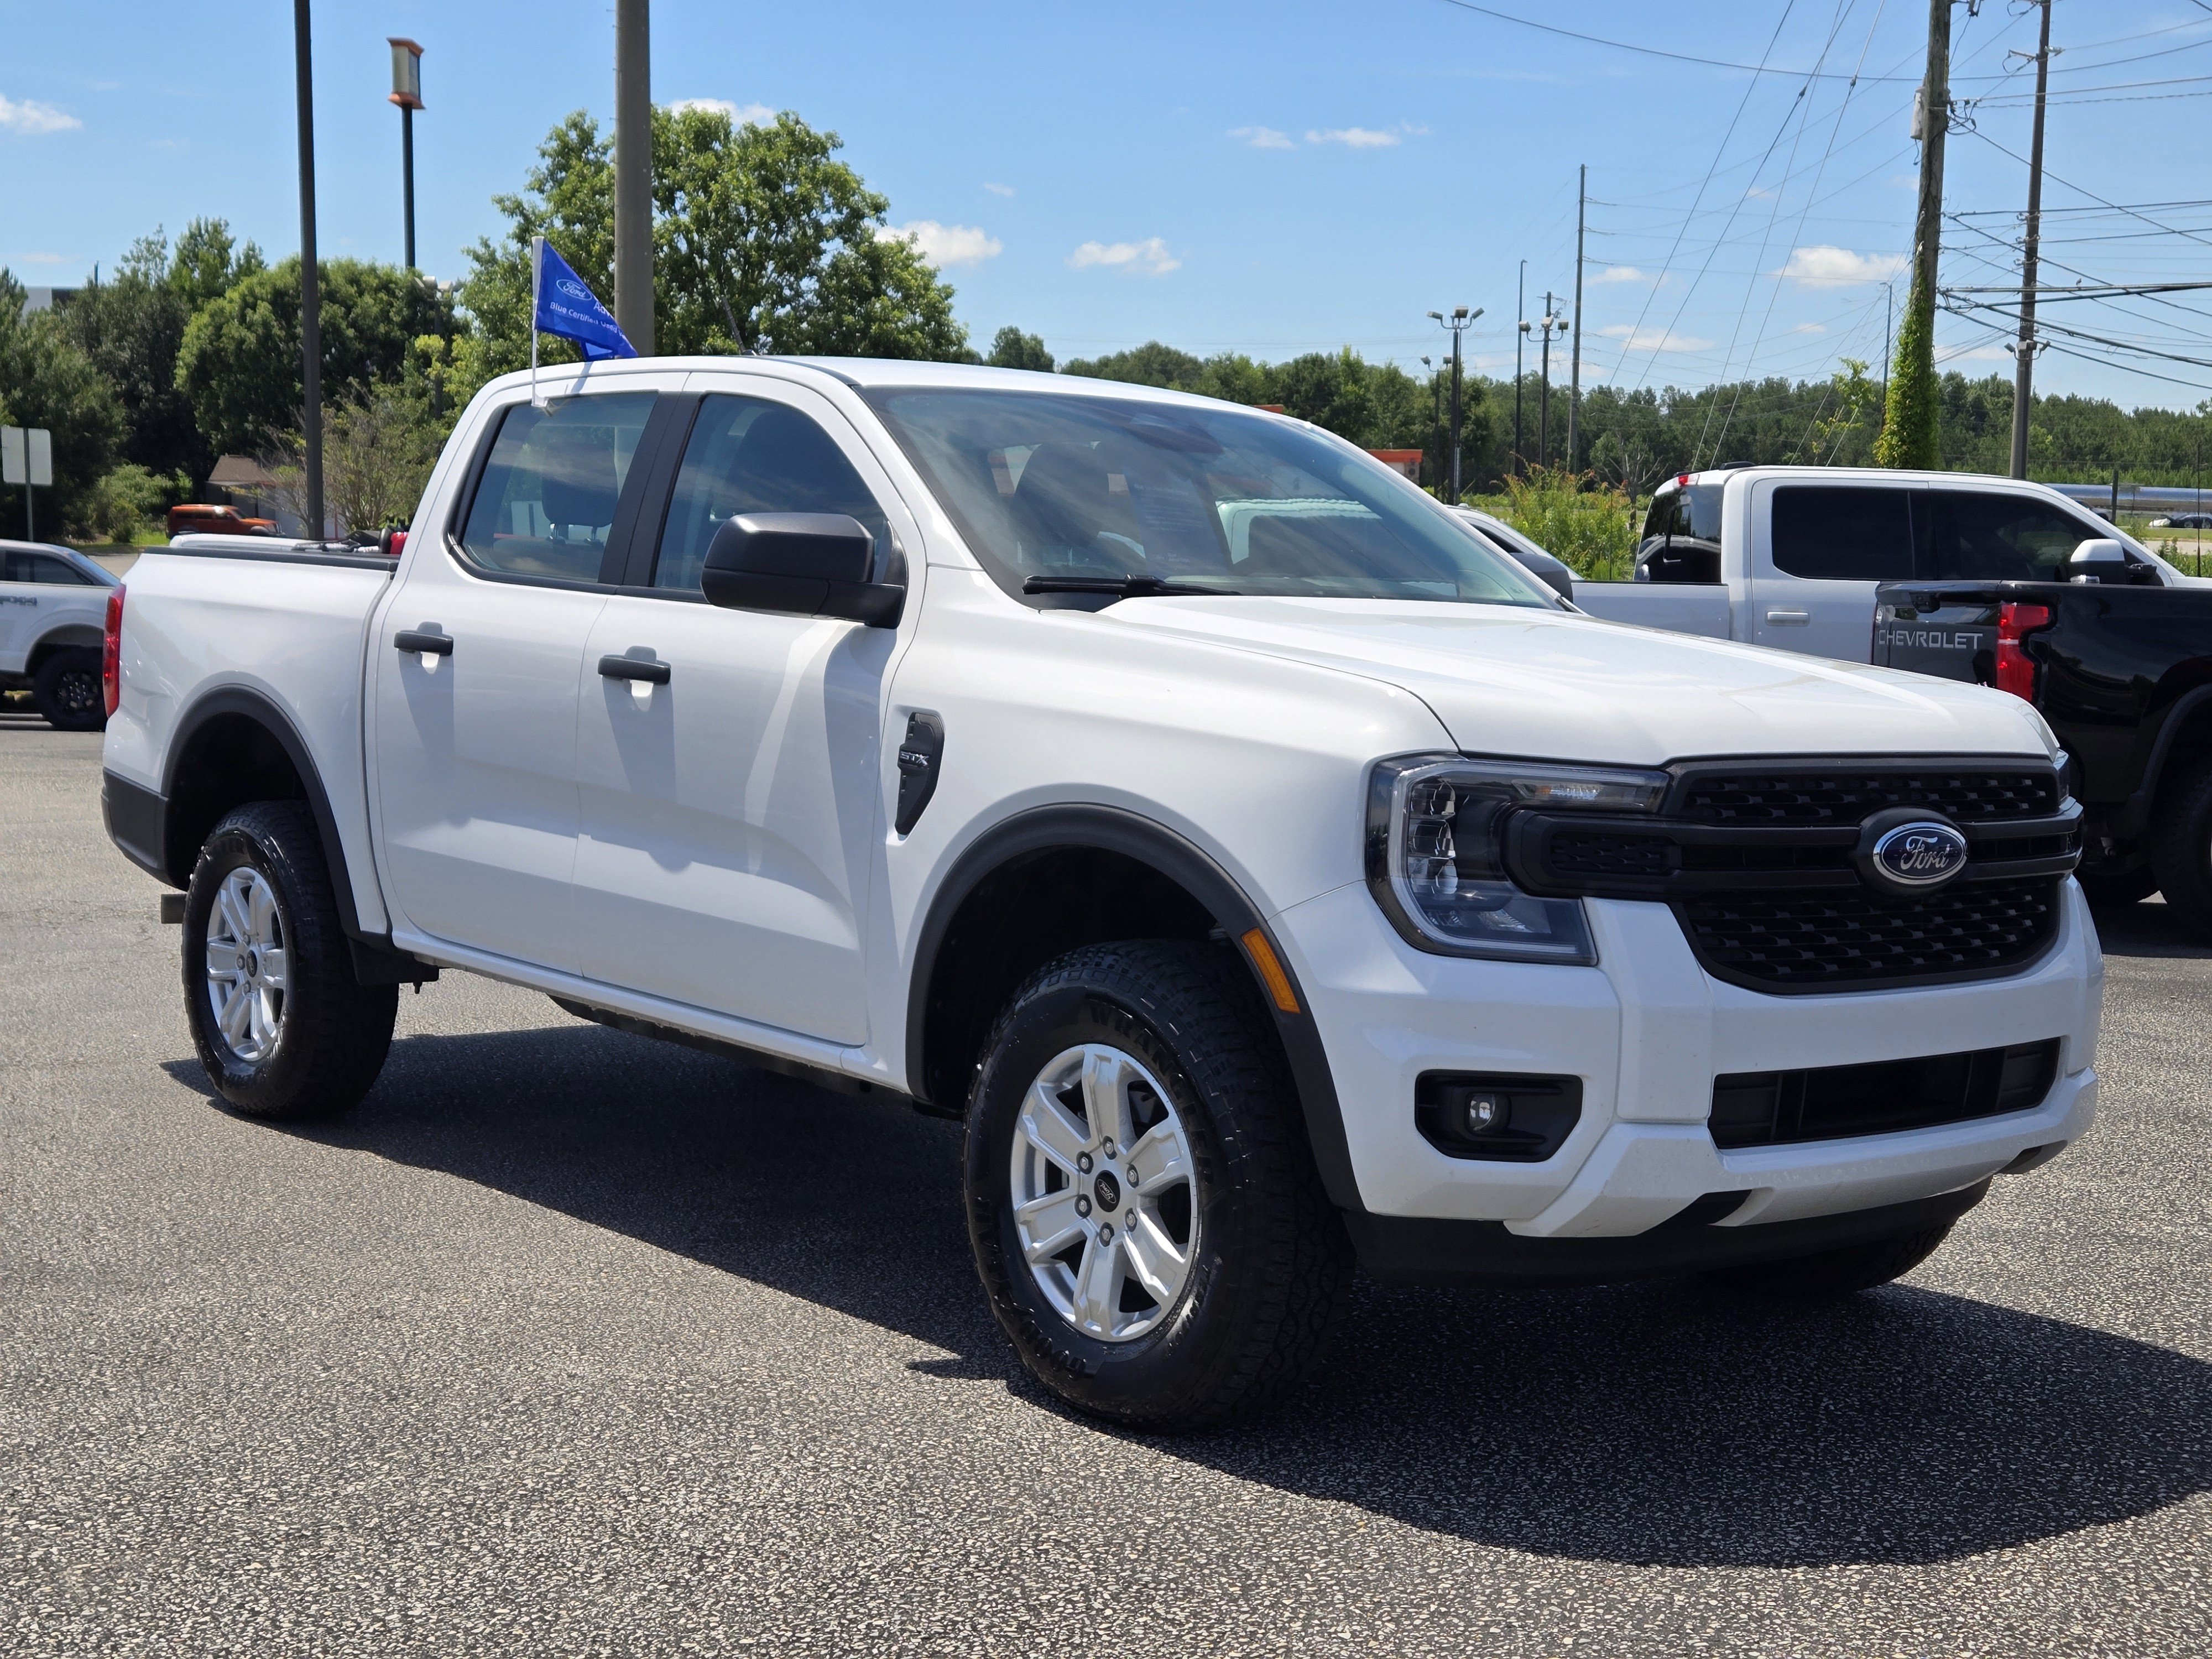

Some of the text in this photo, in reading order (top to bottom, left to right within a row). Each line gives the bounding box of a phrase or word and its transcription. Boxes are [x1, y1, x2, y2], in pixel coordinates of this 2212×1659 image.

[563, 281, 586, 298] Ford
[550, 301, 617, 333] Blue Certified Used
[1878, 629, 1983, 650] CHEVROLET
[900, 751, 930, 766] STX
[1900, 836, 1950, 870] Ford
